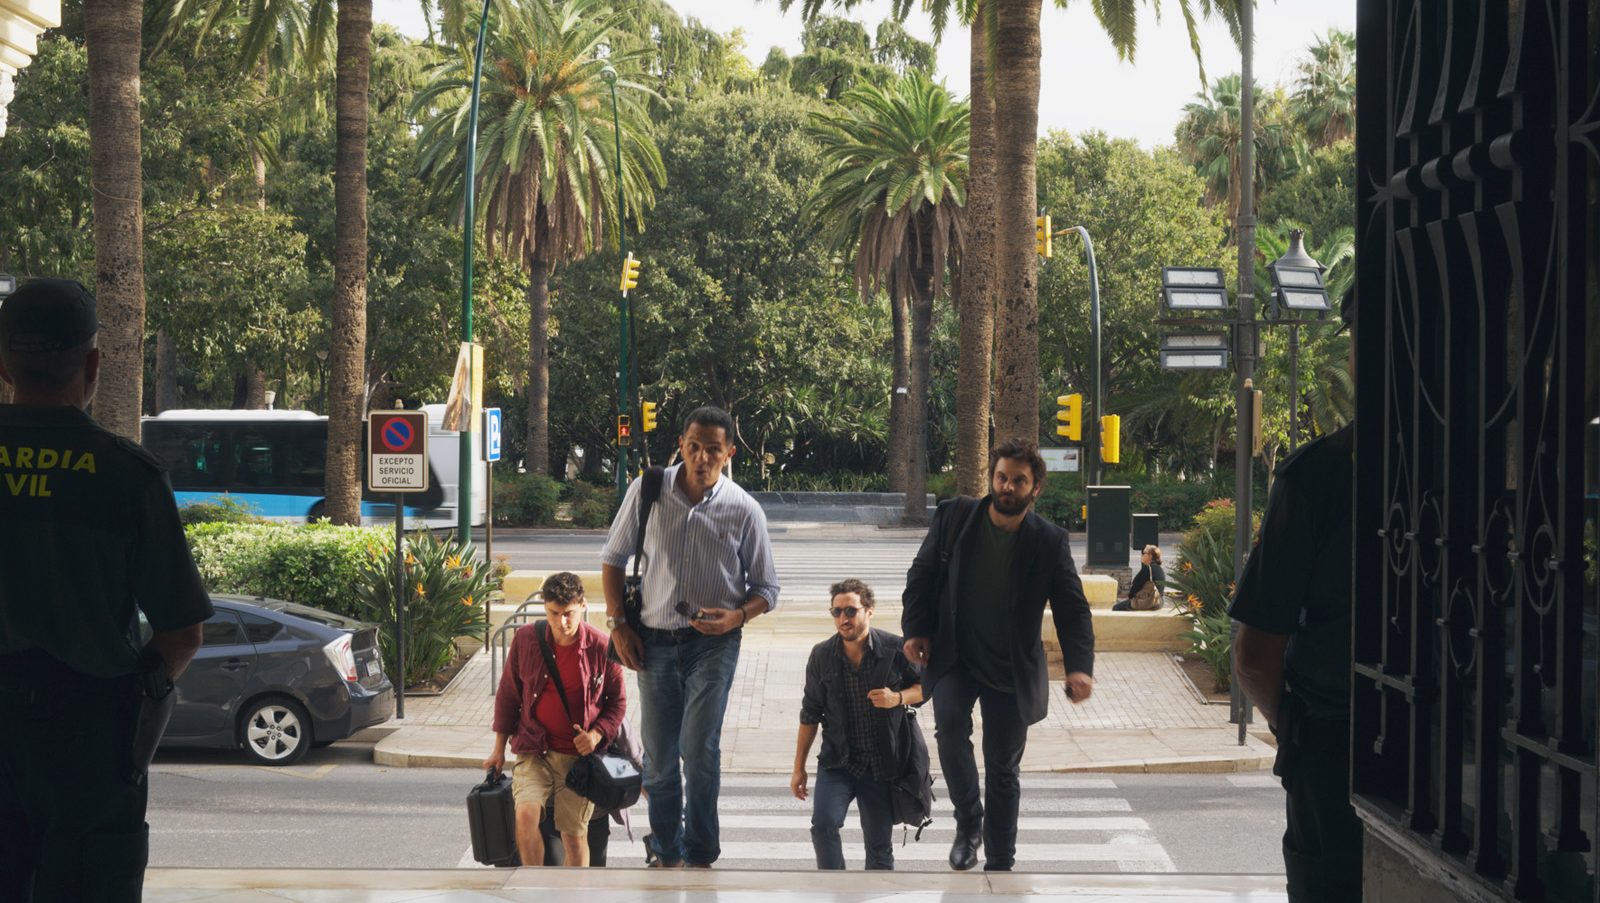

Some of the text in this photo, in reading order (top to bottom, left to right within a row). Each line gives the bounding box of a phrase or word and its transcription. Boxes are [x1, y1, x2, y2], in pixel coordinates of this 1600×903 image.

[379, 457, 414, 465] EXCEPTO
[379, 467, 415, 475] SERVICIO
[381, 477, 411, 485] OFICIAL
